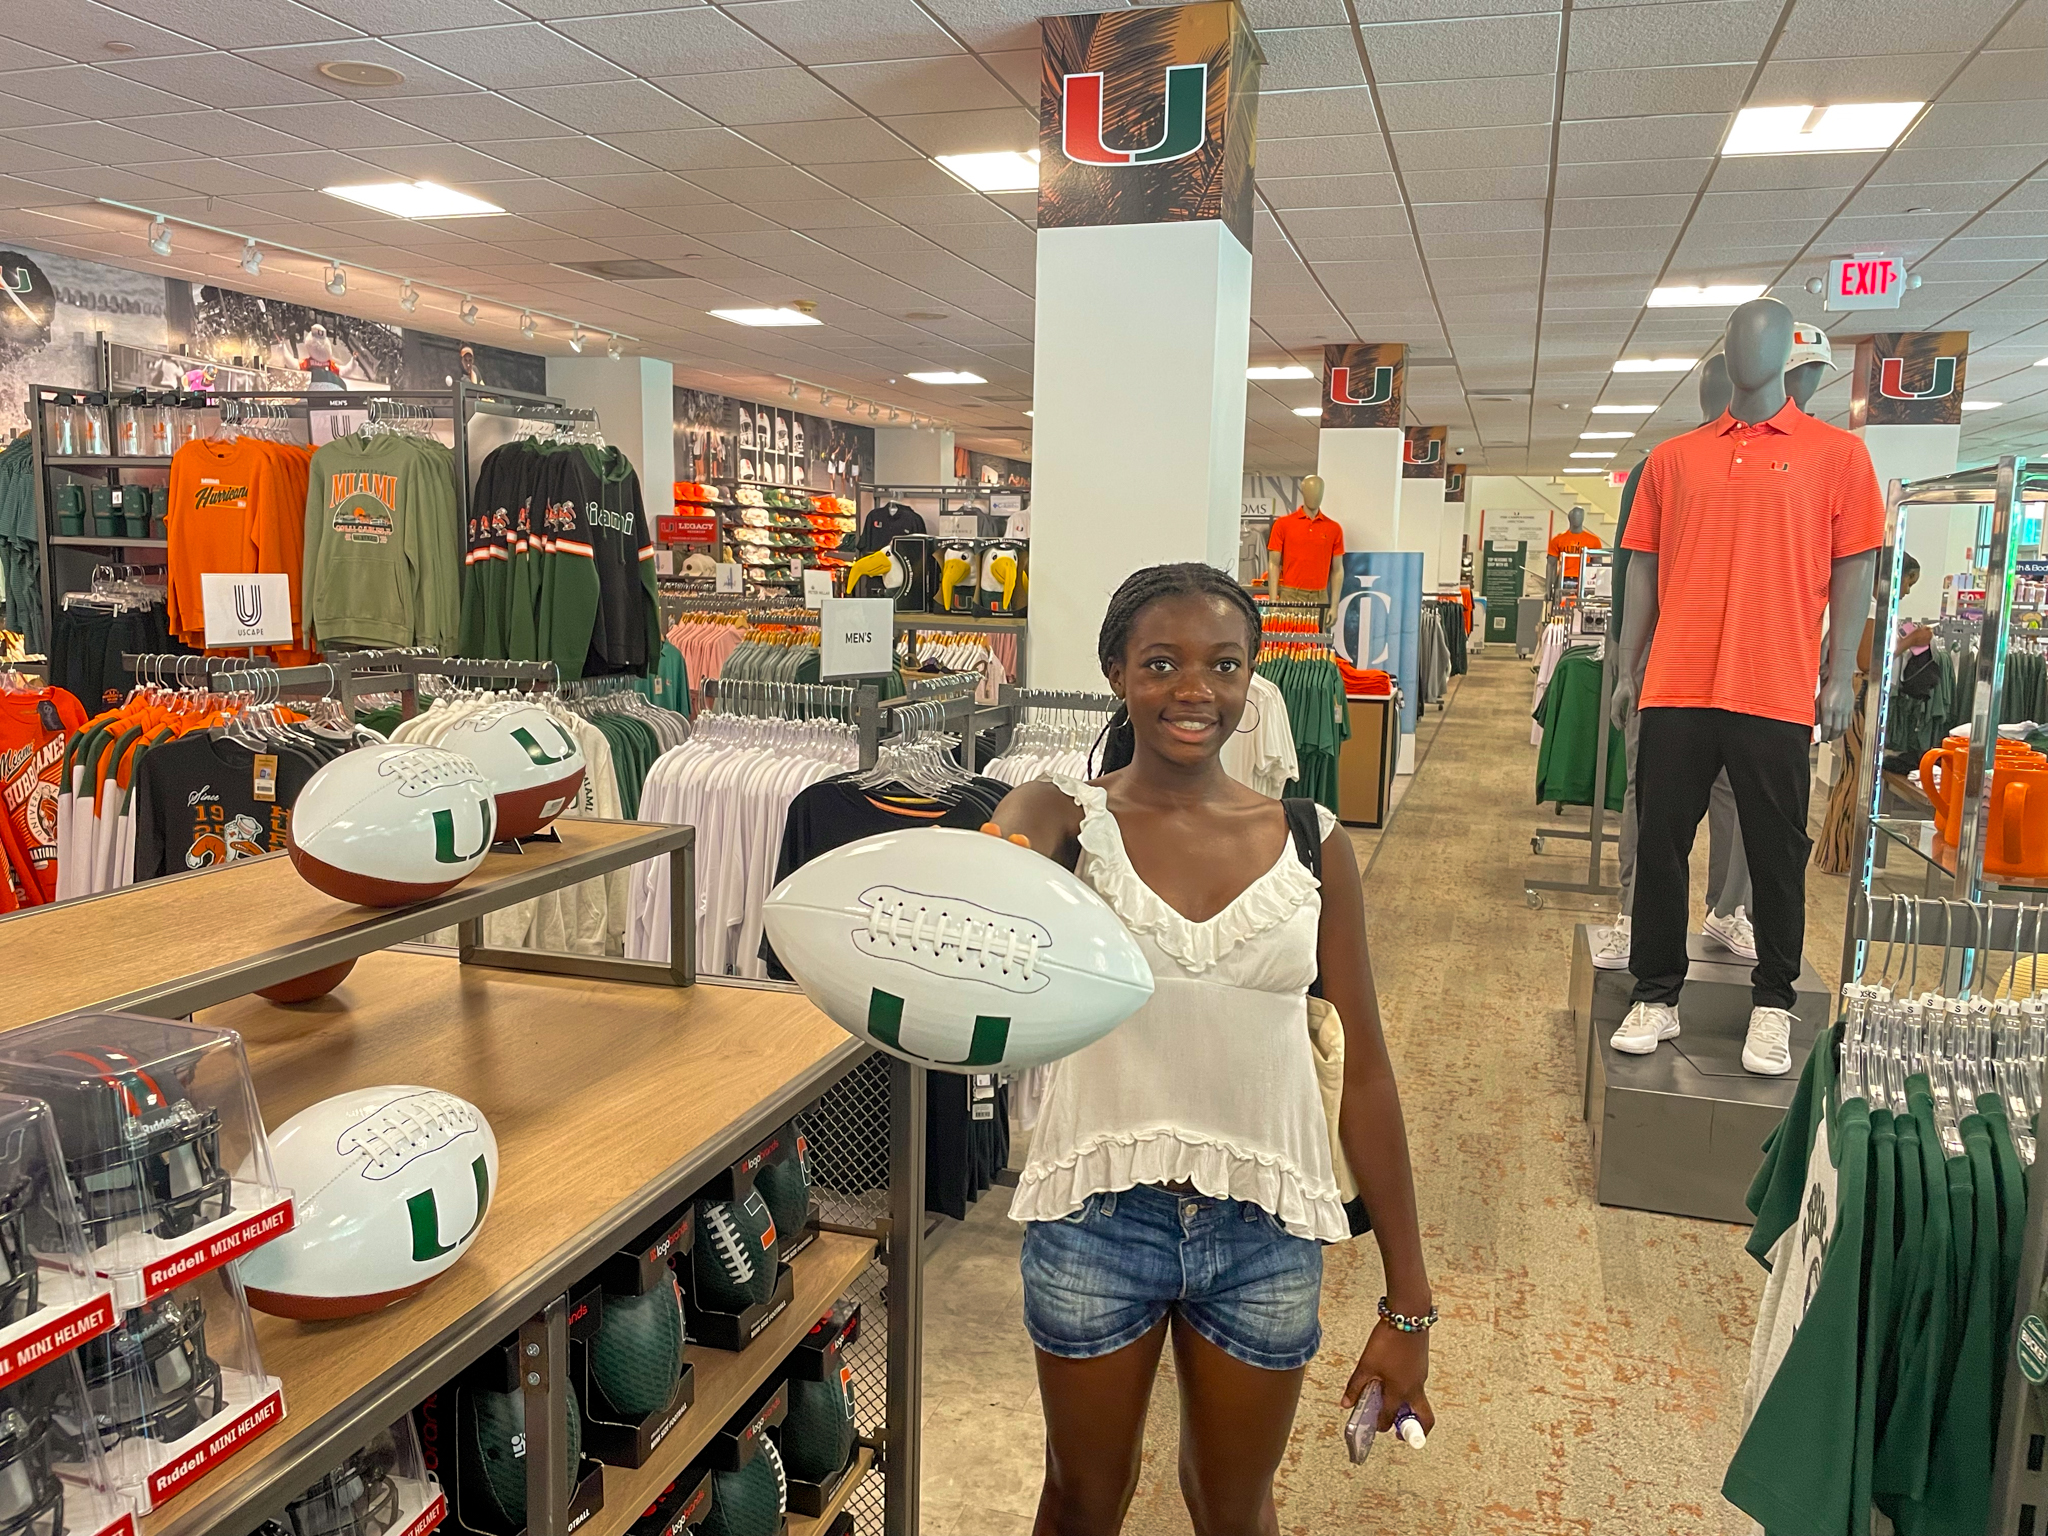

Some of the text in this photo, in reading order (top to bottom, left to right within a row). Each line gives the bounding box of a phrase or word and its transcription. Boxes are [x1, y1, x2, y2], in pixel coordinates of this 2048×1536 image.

[1062, 63, 1207, 167] U
[1840, 261, 1894, 296] EXIT
[1330, 367, 1393, 405] U
[1879, 357, 1957, 400] U
[329, 473, 397, 511] MIAMI
[1613, 471, 1629, 483] EXI
[586, 502, 634, 536] iami
[678, 522, 714, 530] LEGACY
[237, 628, 264, 637] USCAPE
[845, 632, 872, 643] MEN'S
[187, 784, 220, 808] Since
[195, 805, 225, 821] 19
[432, 798, 490, 863] U
[1954, 1005, 1961, 1013] S
[1977, 1005, 1987, 1013] M
[1995, 1005, 2002, 1013] M
[406, 1152, 490, 1262] U
[150, 1210, 285, 1286] Riddell MINI HELMET
[656, 1220, 688, 1257] logobrands
[16, 1308, 104, 1366] MINI HELMET
[156, 1401, 275, 1492] Riddell MINI HELMET
[415, 1503, 440, 1534] HELMET
[567, 1508, 590, 1533] OTBALL
